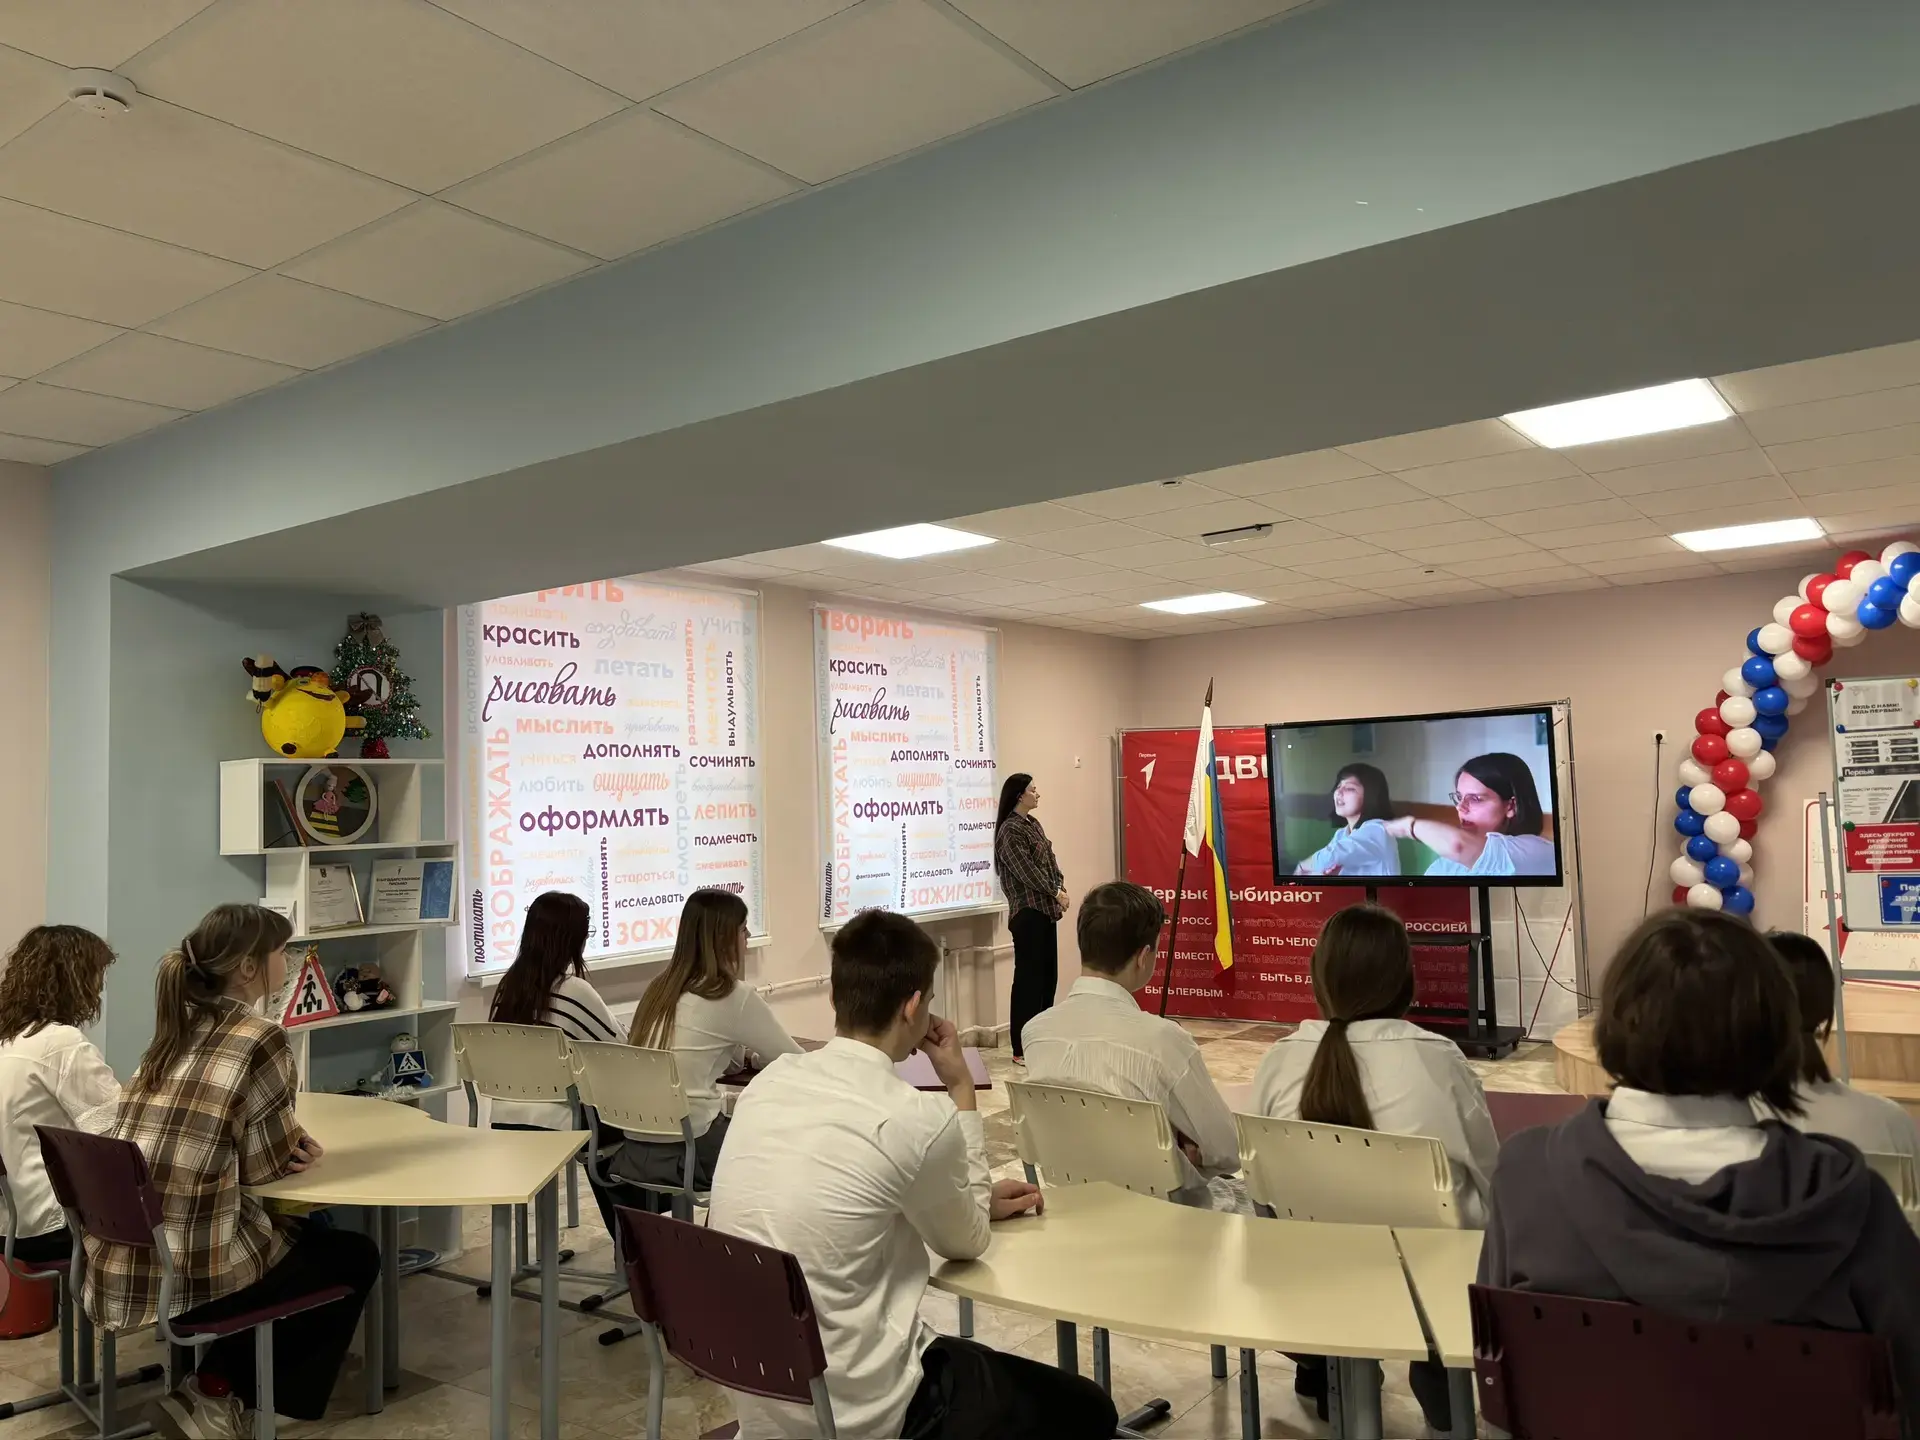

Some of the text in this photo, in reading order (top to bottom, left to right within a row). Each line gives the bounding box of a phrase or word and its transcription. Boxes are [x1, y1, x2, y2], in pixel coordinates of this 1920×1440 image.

[701, 617, 754, 635] учить
[483, 623, 580, 648] красить
[485, 655, 554, 668] улавливать
[595, 658, 674, 679] летать
[829, 658, 888, 676] красить
[685, 618, 698, 746] разглядывать
[482, 661, 617, 722] рисовать
[725, 650, 736, 747] выдумывать
[896, 684, 944, 699] летать
[830, 687, 910, 735] рисовать
[976, 675, 984, 752] выдумывать
[516, 717, 614, 735] мыслить
[850, 731, 909, 743] мыслить
[583, 743, 680, 760] дополнять
[890, 749, 950, 762] дополнять
[689, 755, 755, 768] сочинять
[955, 759, 997, 770] сочинять
[519, 778, 584, 793] любить
[593, 772, 670, 802] ощущать
[853, 776, 892, 788] любить
[694, 802, 757, 820] лепить
[853, 797, 943, 822] оформлять
[959, 797, 998, 811] лепить
[519, 805, 669, 837] оформлять
[675, 763, 691, 887] смотреть
[833, 738, 851, 917] ИЗОБРАЖАТЬ
[958, 821, 996, 832] подмечат
[487, 726, 515, 961] ИЗОБРАЖАТЬ
[694, 833, 757, 846] подмечать
[695, 860, 748, 870] смешивать
[910, 868, 953, 879] исследовать
[614, 870, 675, 884] стараться
[600, 836, 610, 948] воспламенять
[823, 861, 832, 918] постигать
[910, 880, 992, 907] зажигать
[1229, 886, 1323, 905] ыбирают
[614, 893, 684, 909] исследовать
[472, 889, 485, 963] постигать
[1405, 921, 1467, 932] РОССИЕЙ
[1252, 935, 1317, 947] БЫТЬ ЧЕЛО
[1260, 973, 1292, 983] БЫТЬ
[1294, 974, 1302, 983] В
[1176, 987, 1223, 998] ПЕРВЫМ
